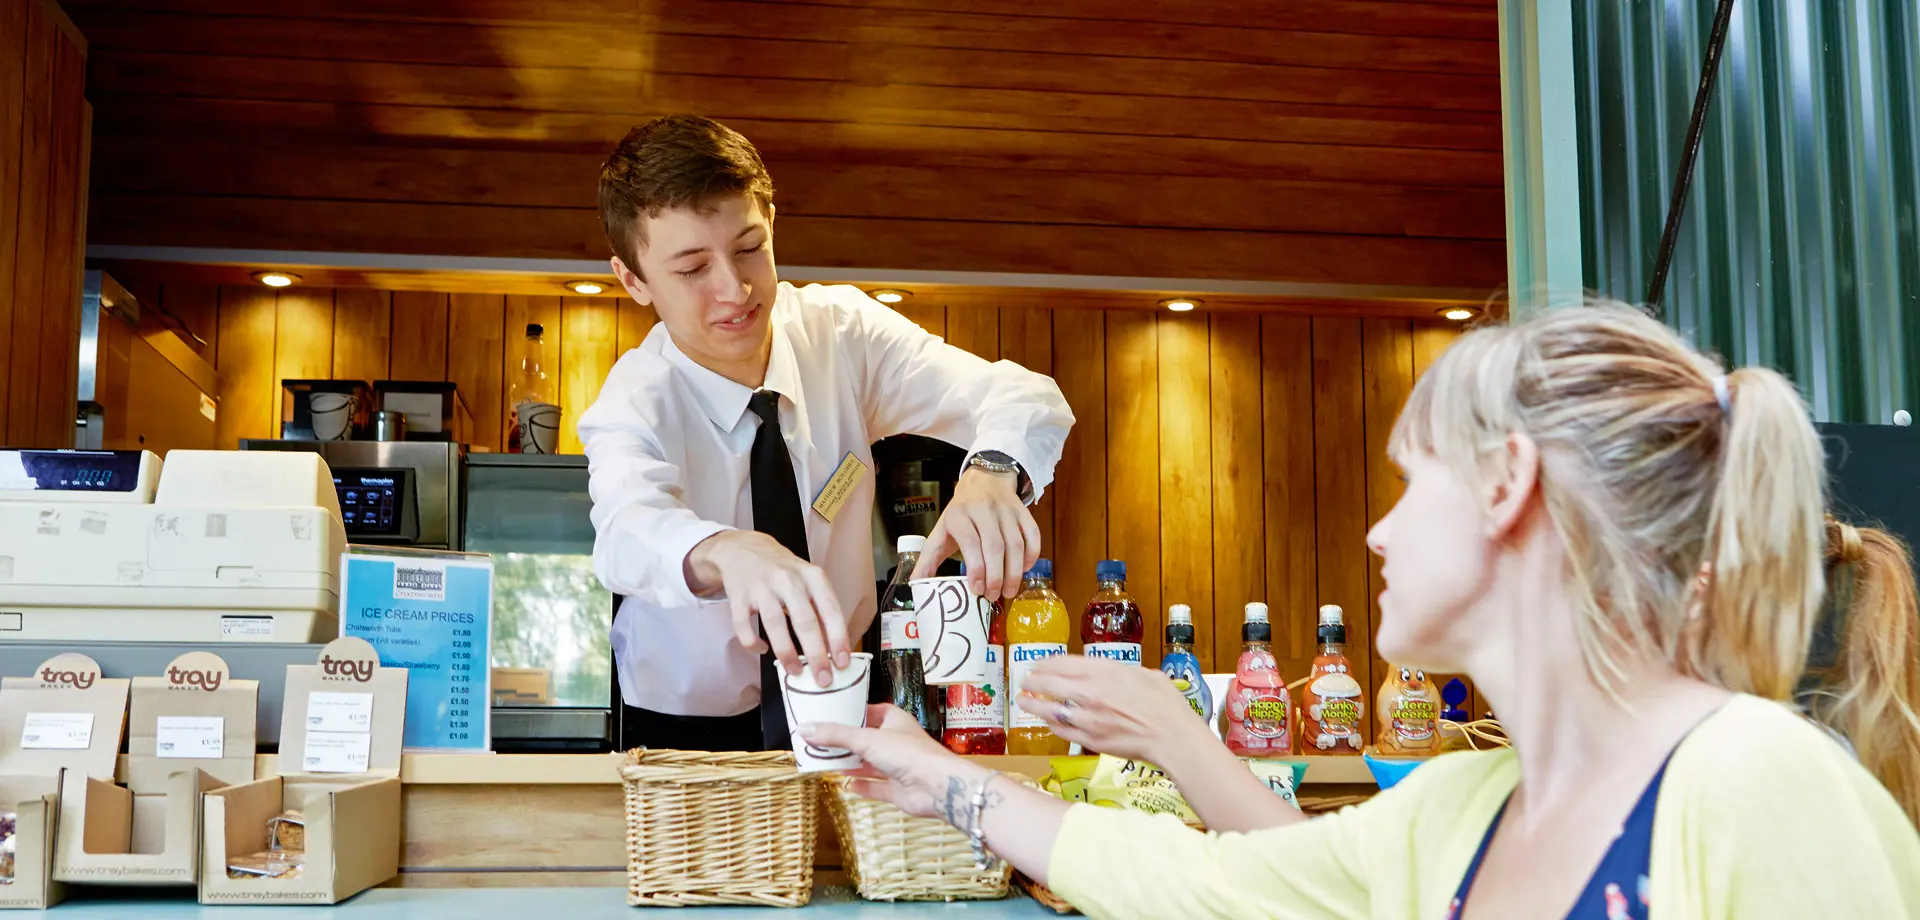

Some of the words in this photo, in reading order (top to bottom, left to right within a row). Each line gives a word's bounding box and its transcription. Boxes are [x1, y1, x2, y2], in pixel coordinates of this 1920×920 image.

[361, 607, 382, 619] ICE
[385, 608, 428, 621] CREAM
[431, 611, 474, 624] PRICES
[346, 623, 384, 632] Chatsworth
[386, 625, 402, 633] Tubs
[1014, 646, 1067, 662] drench
[1088, 646, 1141, 662] drench
[321, 654, 374, 682] tray
[41, 667, 95, 689] tray
[168, 666, 222, 691] tray
[1249, 699, 1285, 711] Happy
[1324, 701, 1355, 711] Funky
[1400, 701, 1434, 712] Merry
[1321, 709, 1359, 723] Monkey
[1391, 709, 1438, 720] Meerkat
[1128, 791, 1184, 818] CHEDDAR
[61, 866, 187, 877] www.traybakes.com
[207, 890, 327, 900] www.traybakes.com
